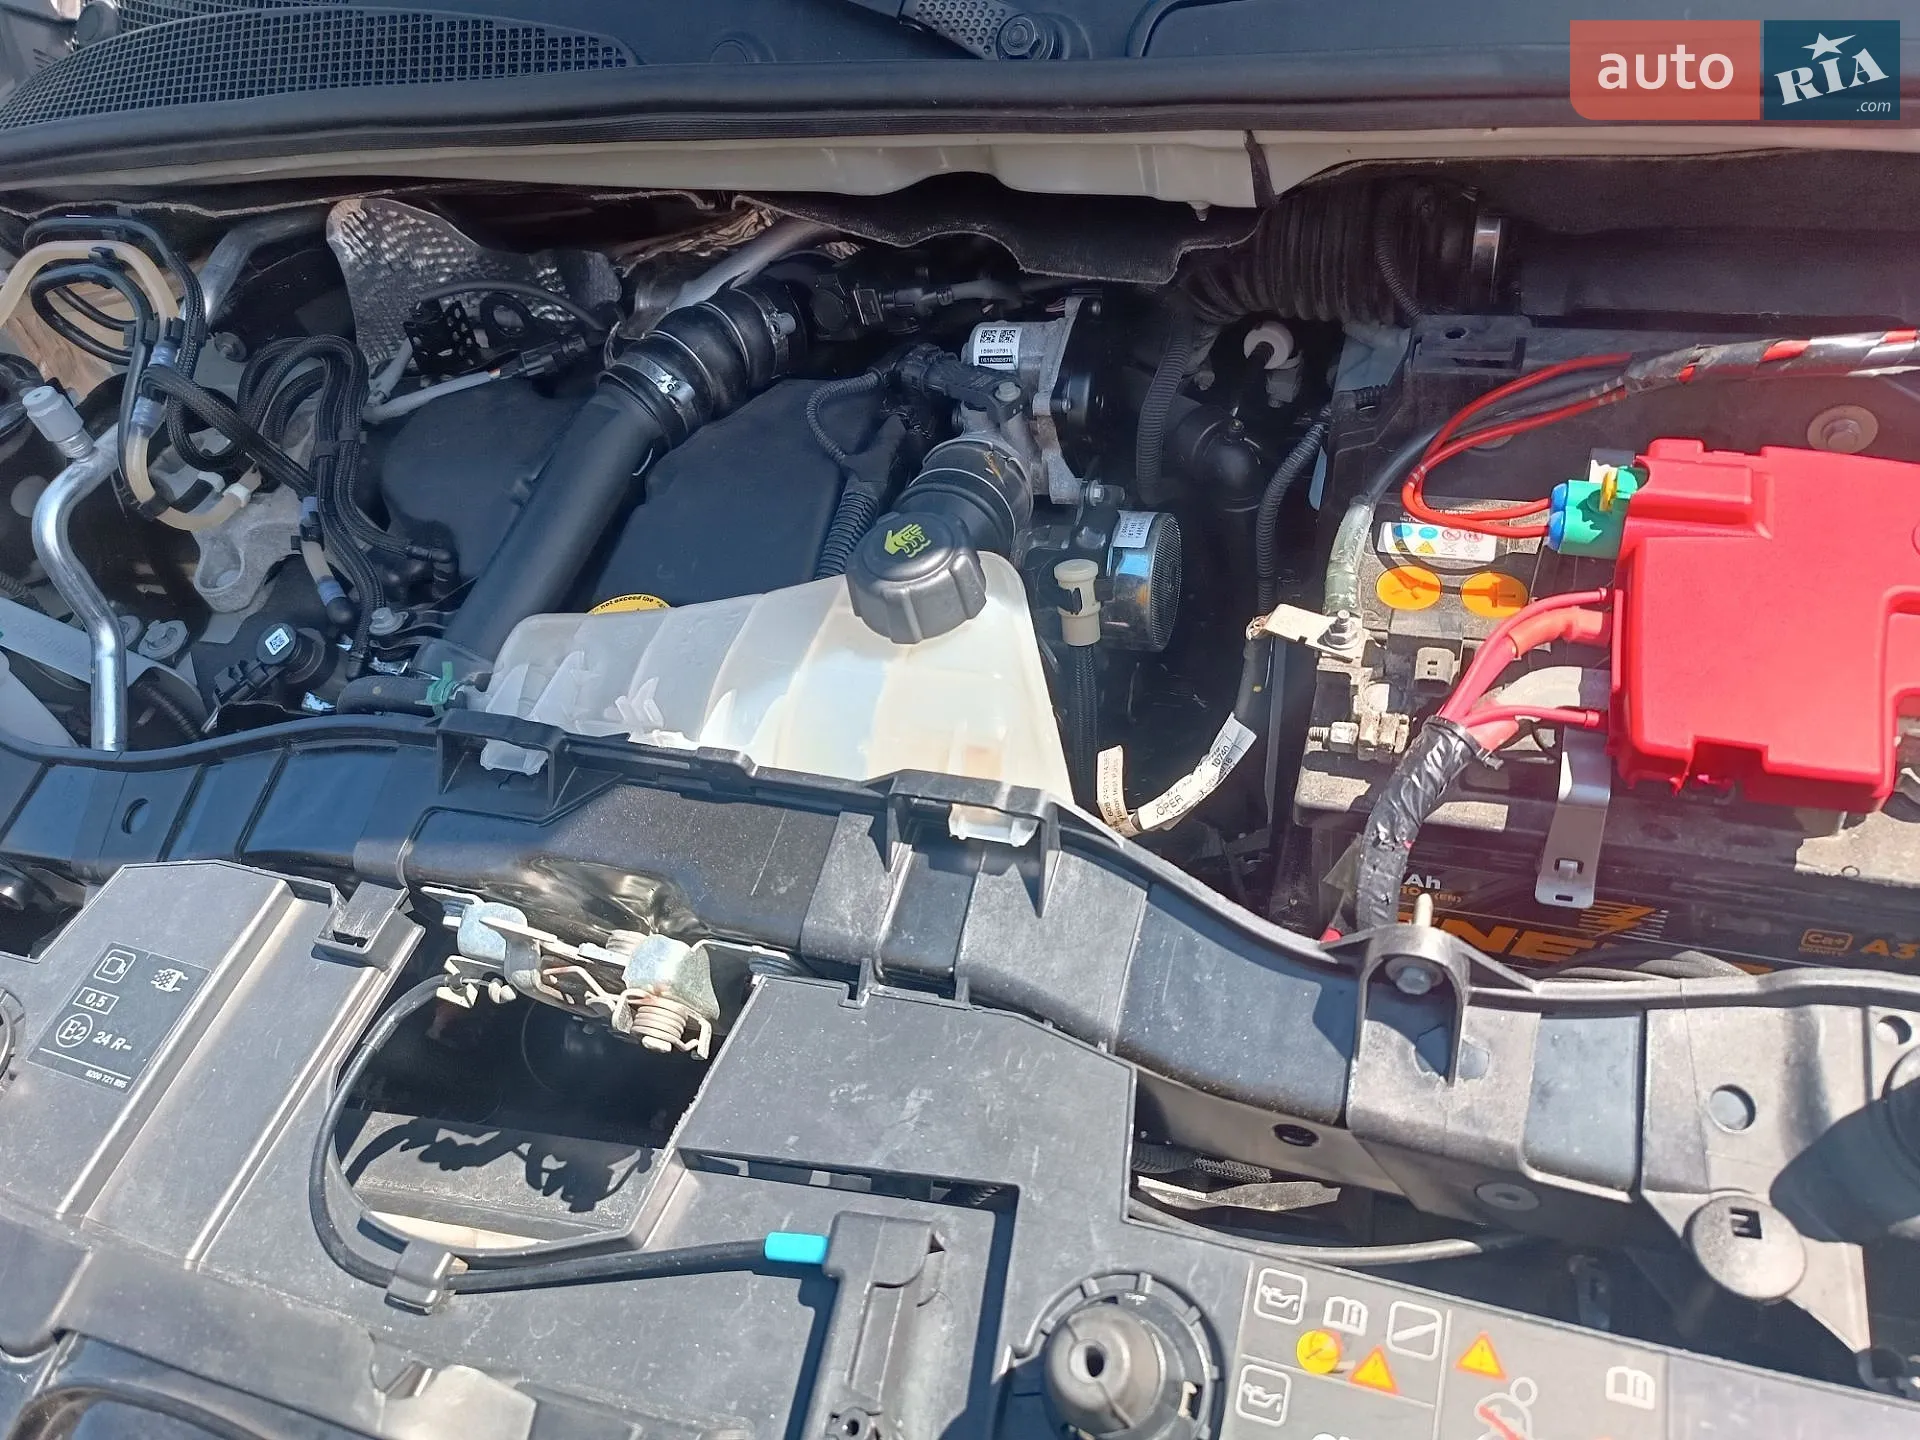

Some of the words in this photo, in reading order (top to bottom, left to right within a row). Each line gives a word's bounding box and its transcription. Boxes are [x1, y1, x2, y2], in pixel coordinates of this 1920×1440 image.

[85, 992, 108, 1008] 0,5
[59, 1019, 87, 1041] E2
[93, 1031, 112, 1047] 24
